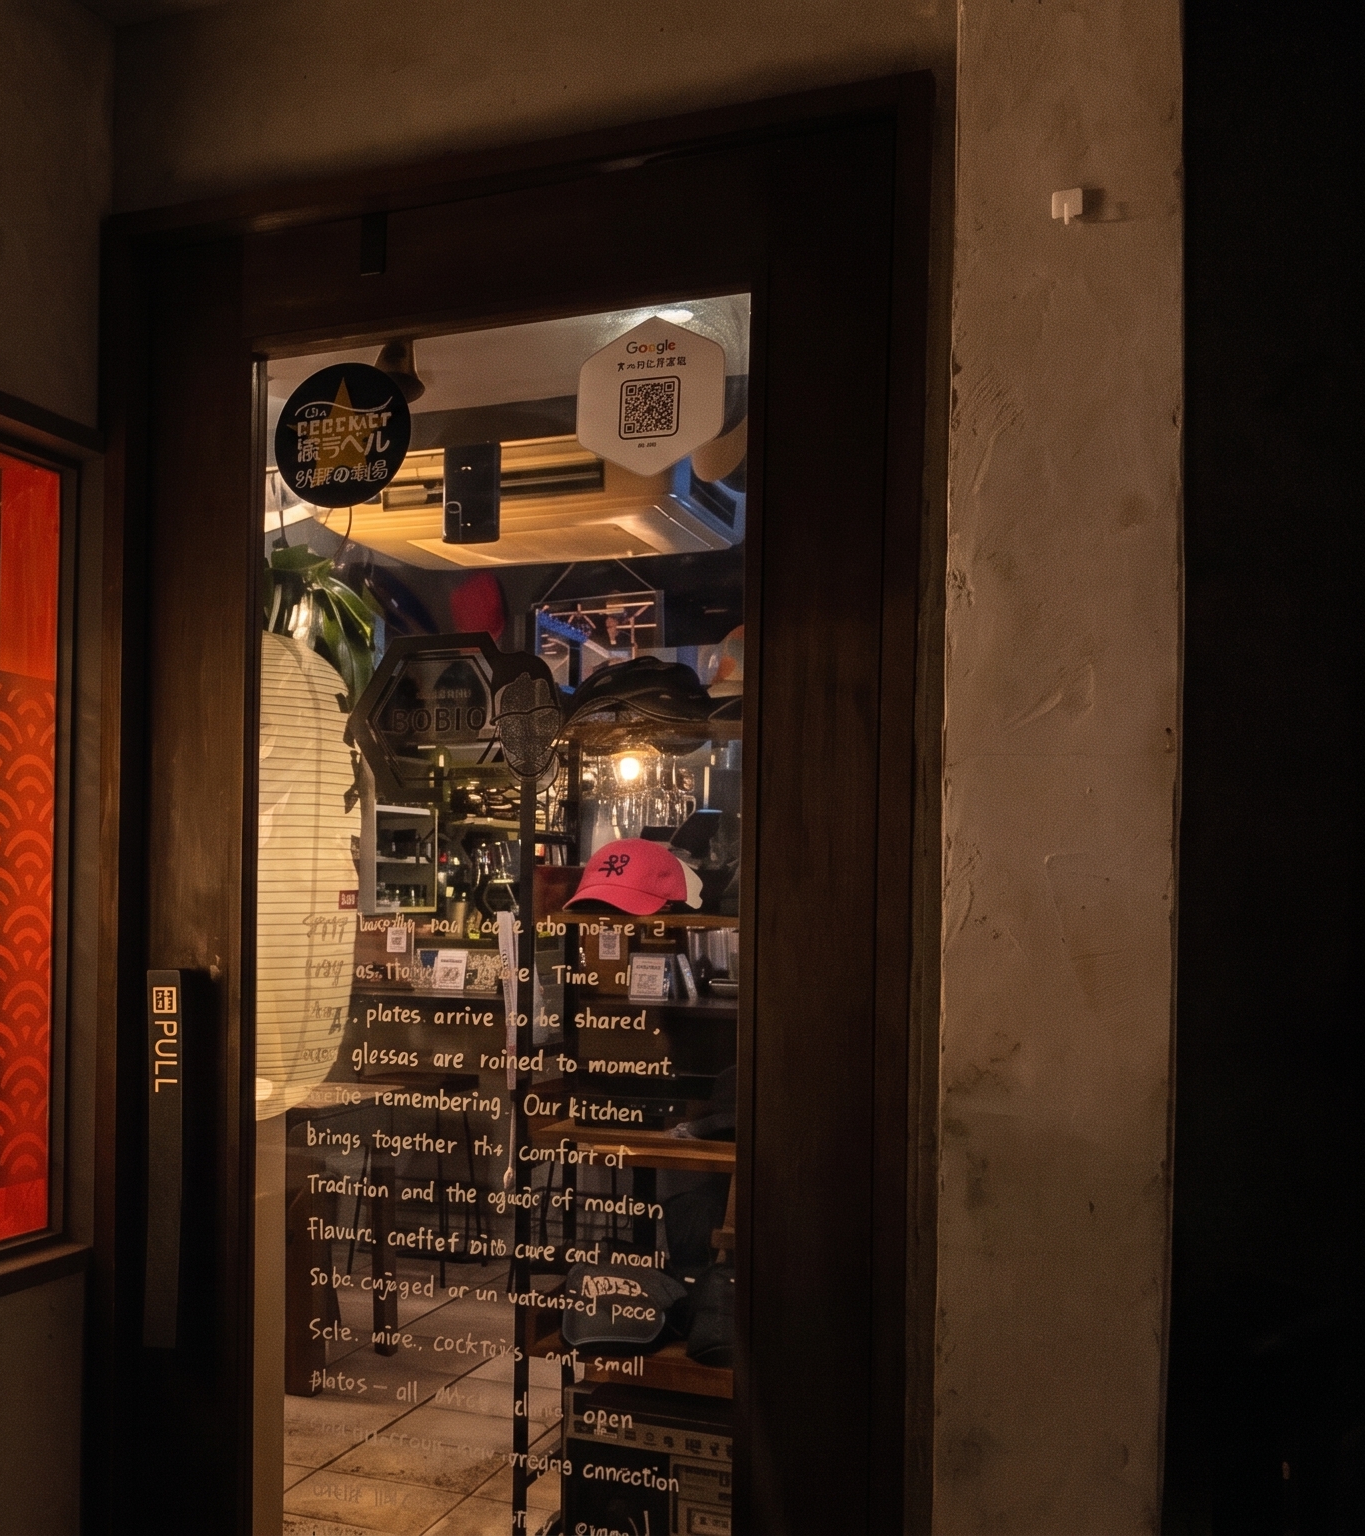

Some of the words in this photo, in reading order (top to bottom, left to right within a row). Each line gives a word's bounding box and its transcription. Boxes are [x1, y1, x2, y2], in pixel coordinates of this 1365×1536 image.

[626, 339, 676, 355] Google
[392, 707, 487, 735] BOBIO
[552, 965, 600, 986] Time
[367, 1003, 421, 1028] plates
[434, 1006, 494, 1027] arrive
[509, 1011, 528, 1027] to
[539, 1007, 561, 1027] be
[154, 1021, 178, 1093] PULL
[433, 1052, 464, 1069] are
[556, 1053, 578, 1072] to
[523, 1093, 561, 1117] Our
[568, 1096, 643, 1123] kitchen
[372, 1130, 457, 1157] together
[519, 1138, 598, 1165] comfort
[307, 1174, 389, 1198] Tradition
[401, 1181, 435, 1202] and
[446, 1183, 477, 1203] the
[552, 1188, 574, 1211] of
[594, 1356, 644, 1377] small
[396, 1381, 418, 1403] all
[583, 1409, 634, 1430] open
